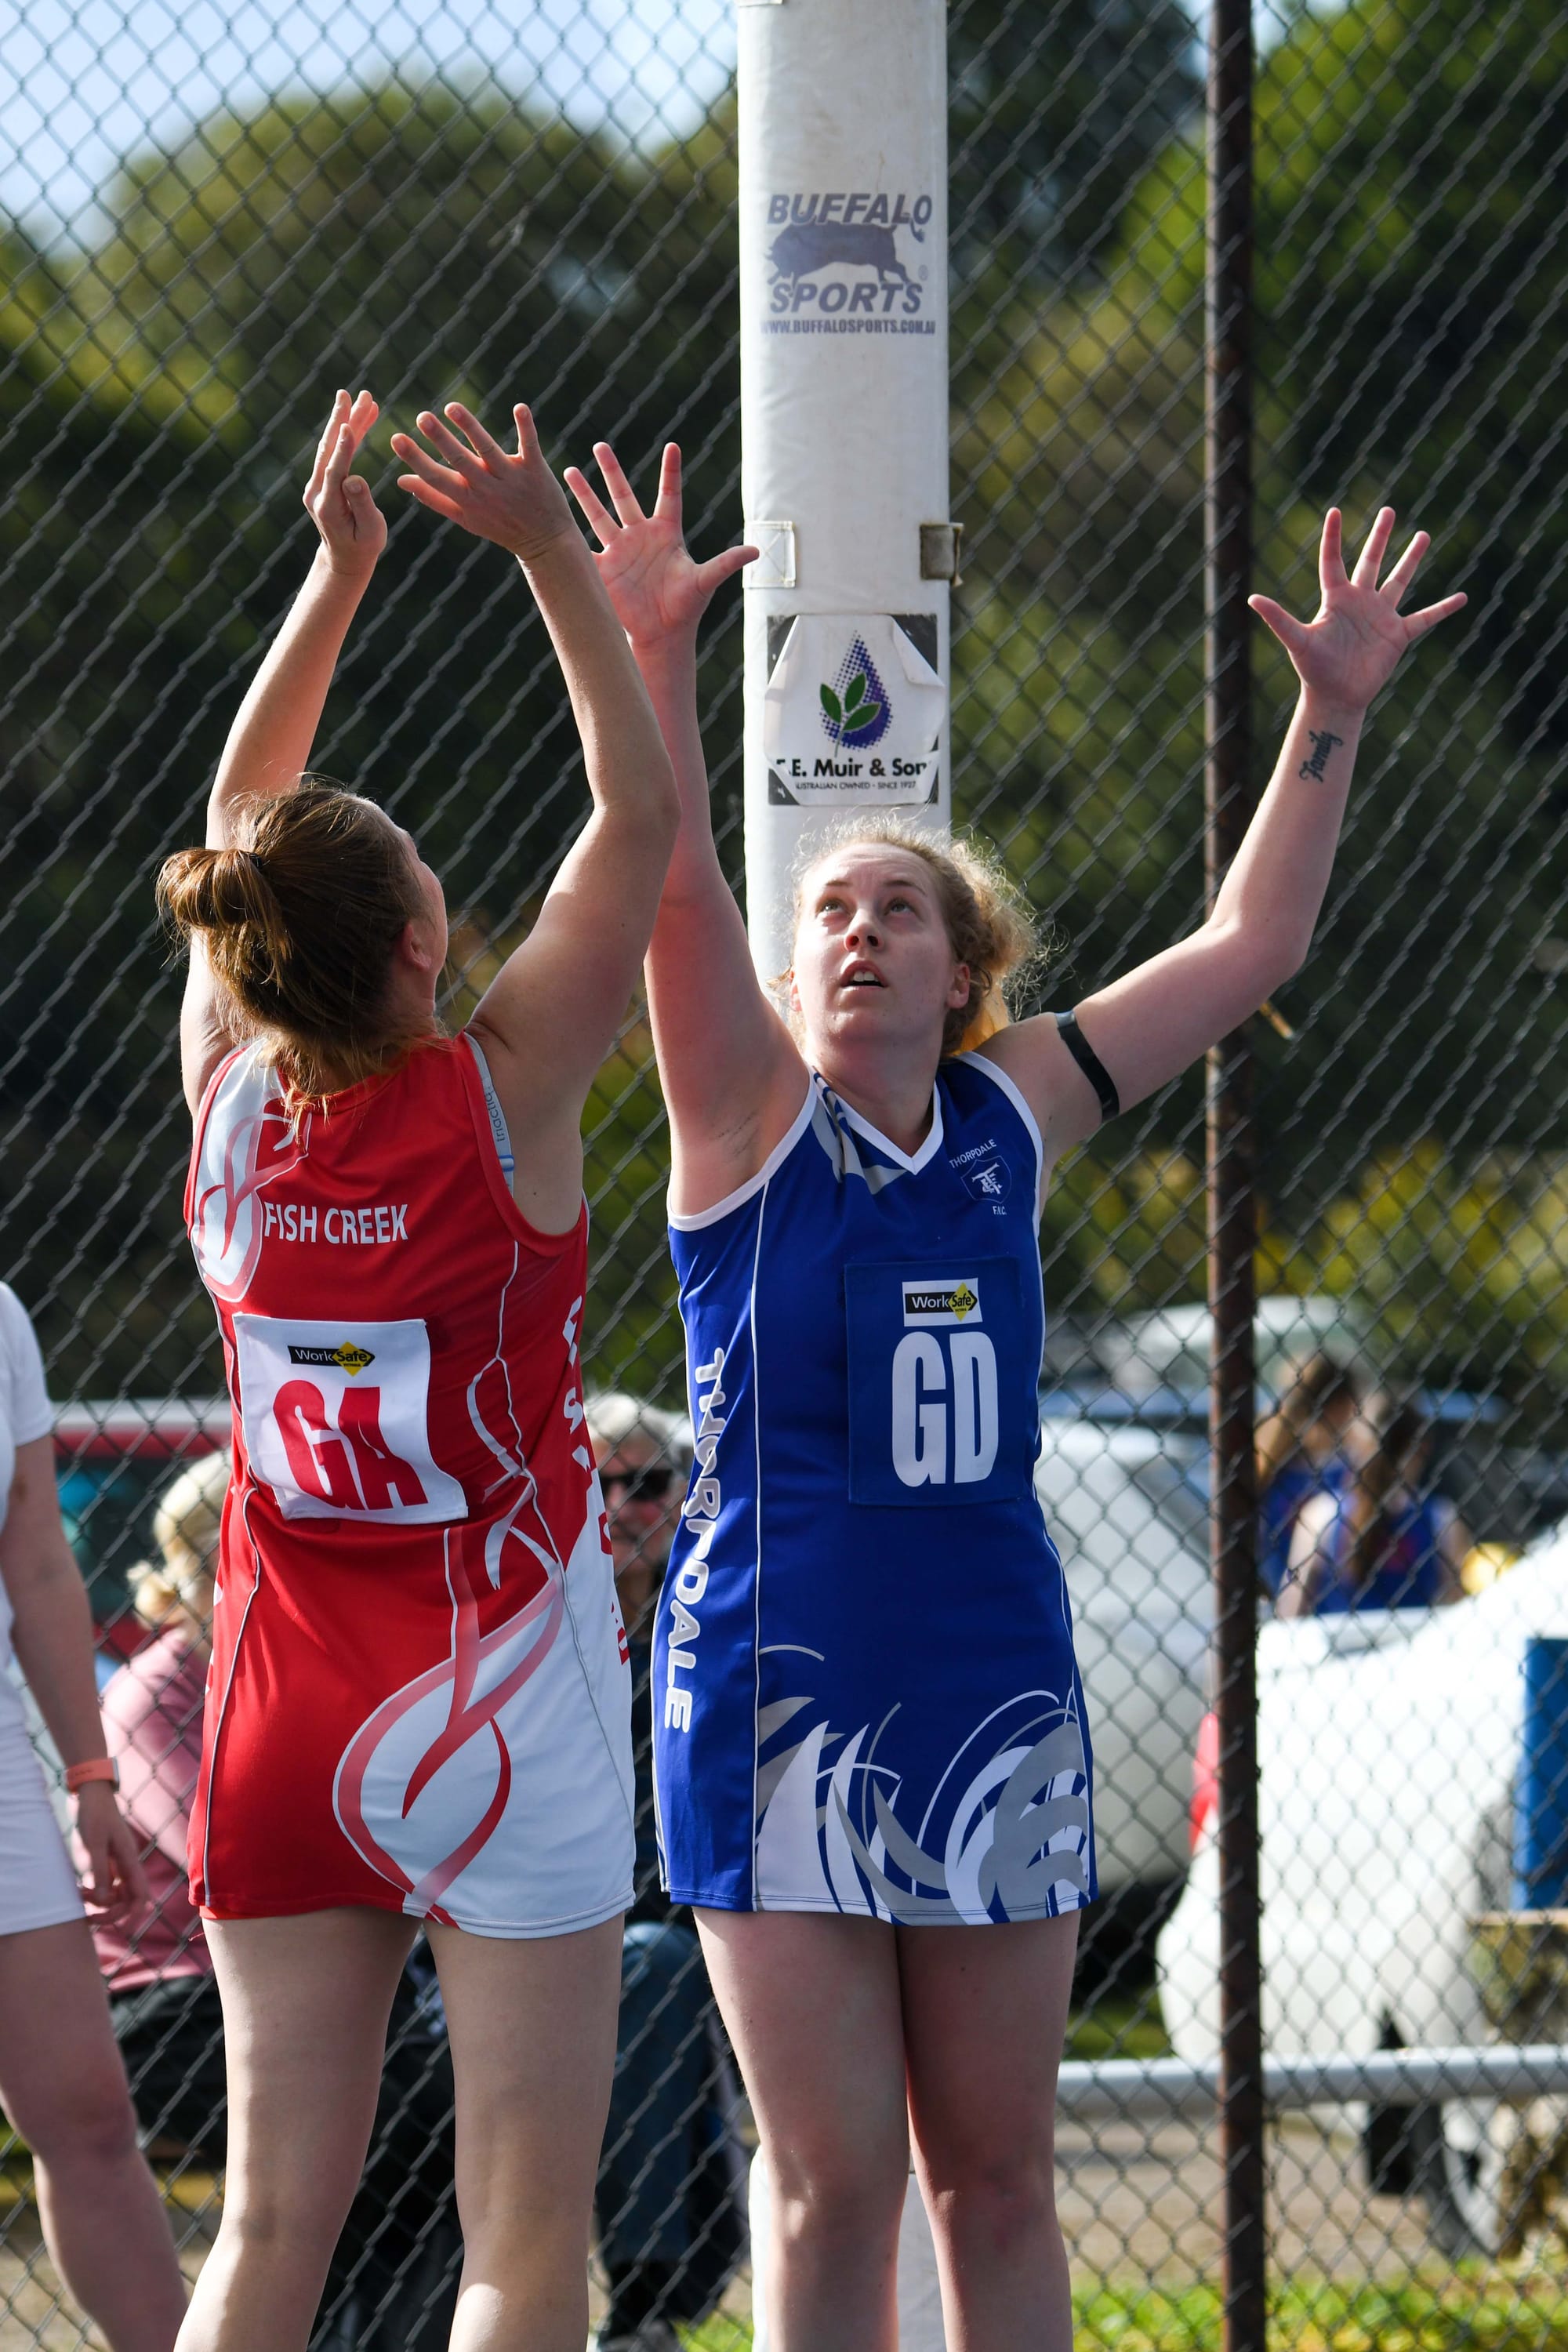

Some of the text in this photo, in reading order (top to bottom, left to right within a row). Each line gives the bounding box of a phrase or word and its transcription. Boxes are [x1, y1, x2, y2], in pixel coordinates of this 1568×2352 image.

[767, 194, 932, 225] BUFFALO
[770, 282, 923, 314] SPORTS
[760, 318, 936, 335] WWW.BUFFALOSPORTS.COM.AU
[813, 757, 863, 777] Muir
[869, 758, 886, 777] &
[840, 780, 870, 789] OWNED
[877, 781, 898, 790] SINCE
[949, 1138, 996, 1168] THORPDALE
[264, 1201, 408, 1244] FISH CREEK
[892, 1331, 999, 1487] GD
[272, 1380, 429, 1511] GA
